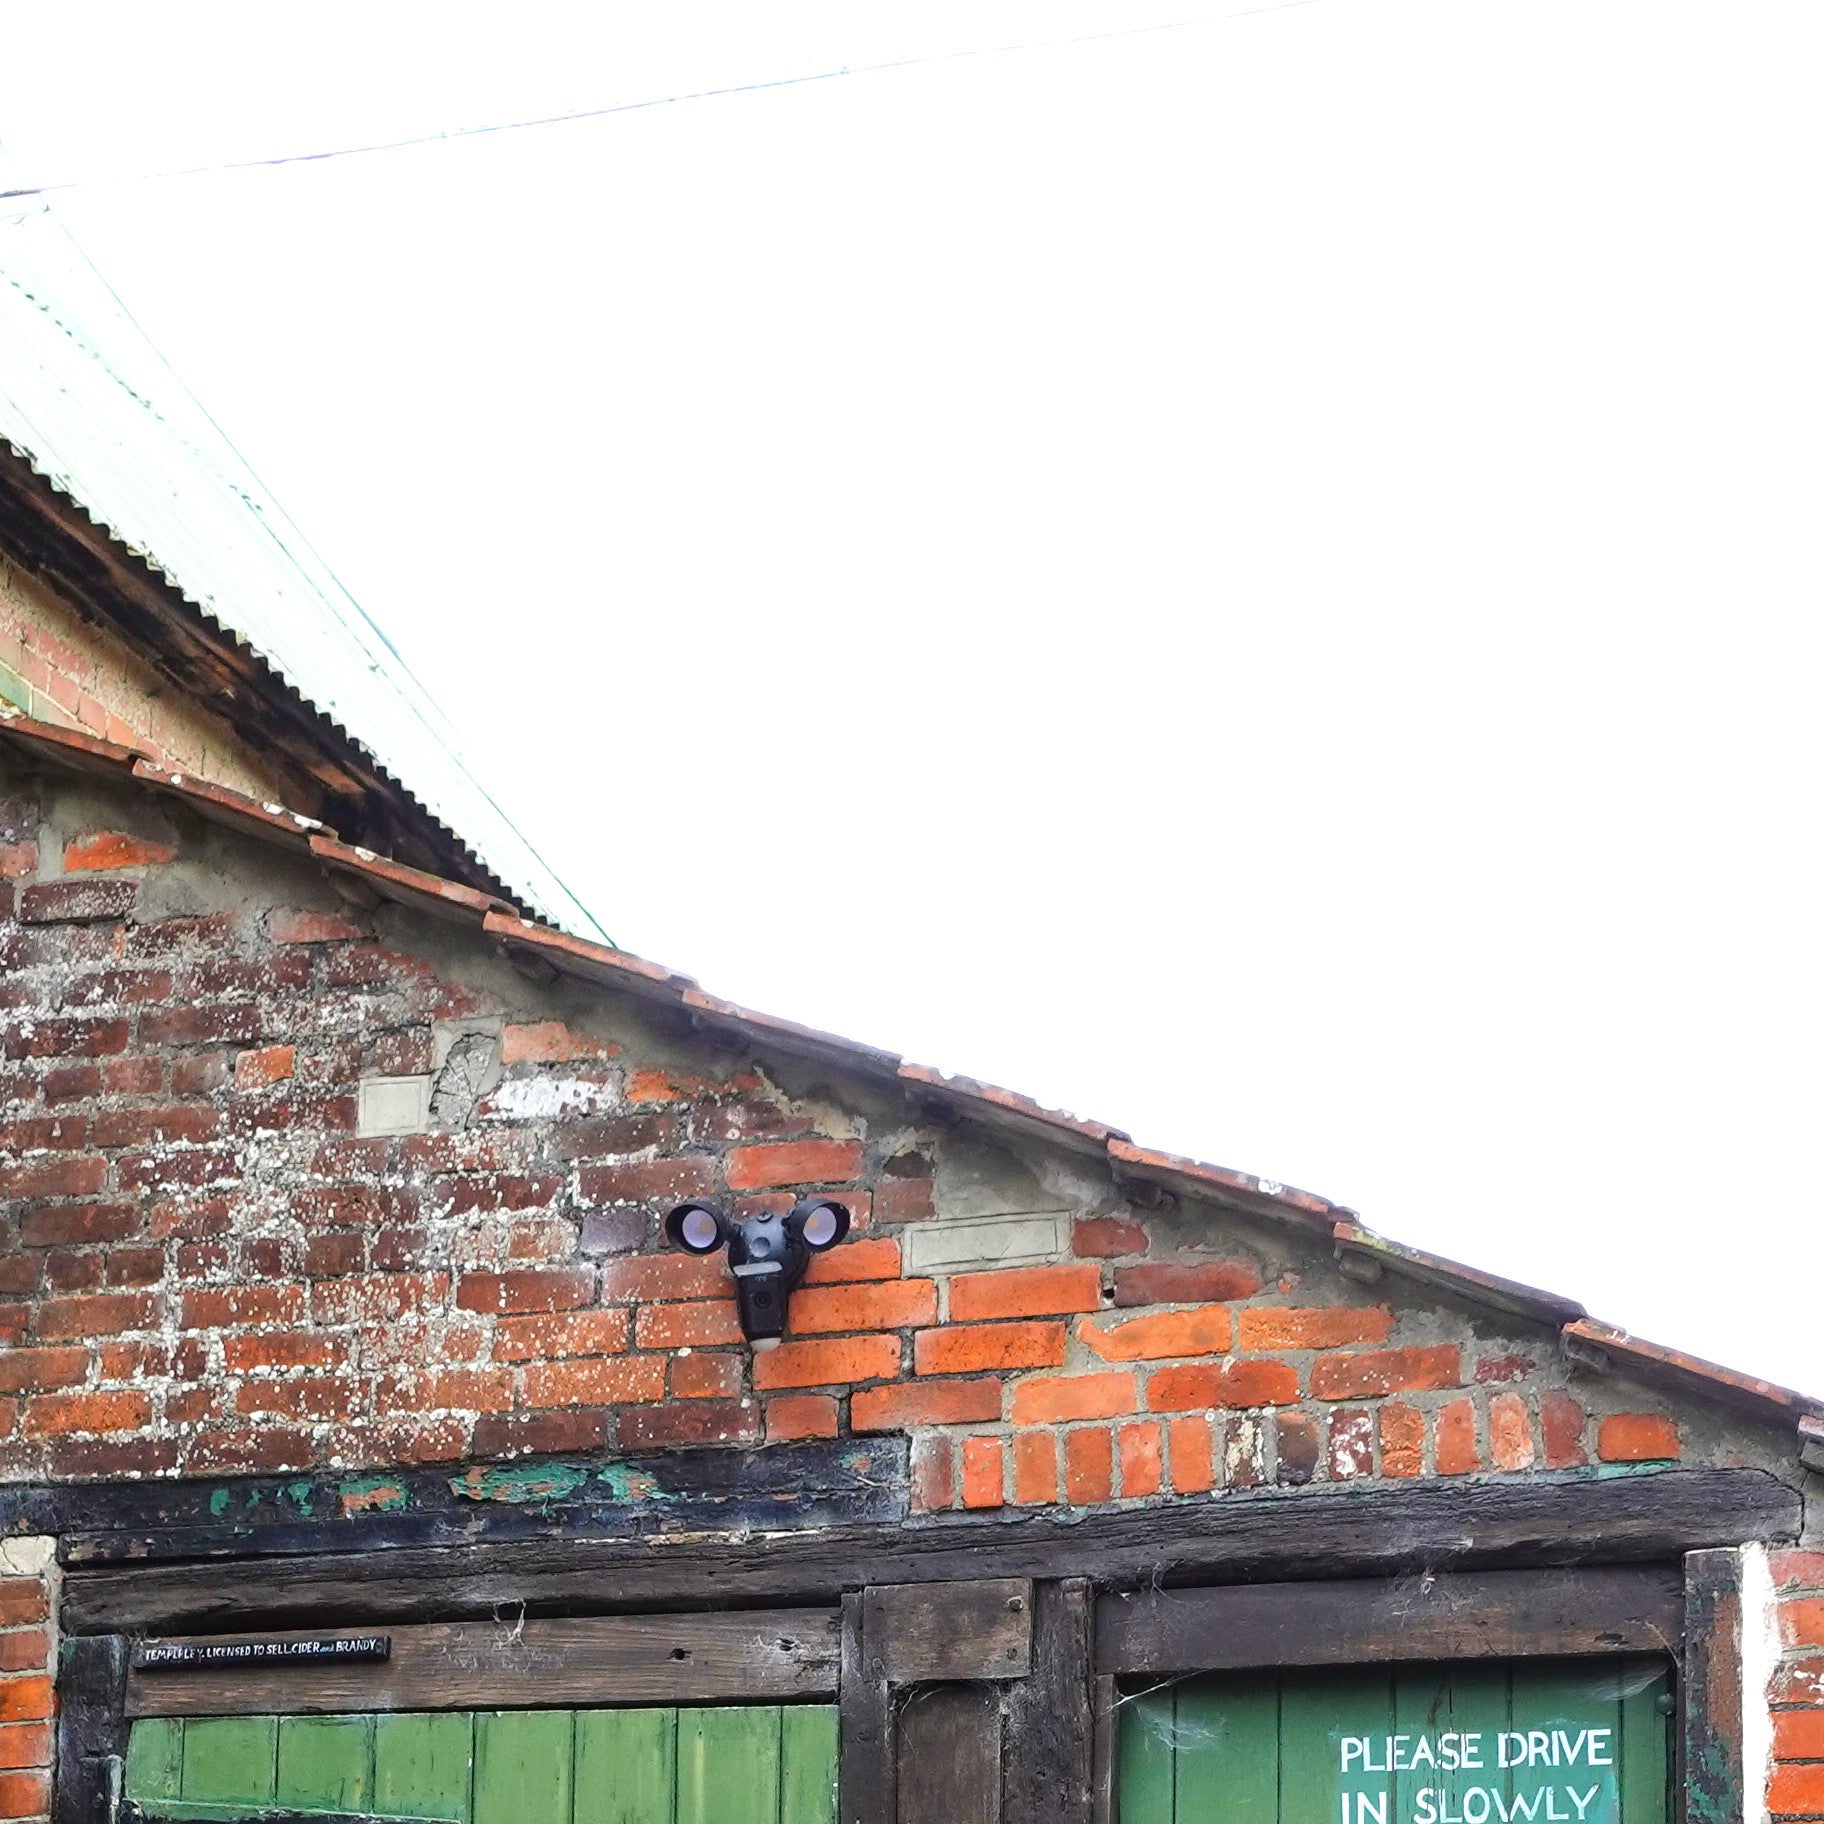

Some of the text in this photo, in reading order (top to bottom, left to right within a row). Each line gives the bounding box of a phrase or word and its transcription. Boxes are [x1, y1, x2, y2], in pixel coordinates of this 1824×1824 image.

[207, 1645, 251, 1658] LICENSED
[253, 1644, 265, 1656] TO
[266, 1643, 291, 1655] SELL
[291, 1641, 320, 1654] CIDER
[336, 1638, 376, 1653] BRANDY
[1340, 1728, 1613, 1772] PLEASE DRIVE
[1412, 1782, 1601, 1824] SLOWLY
